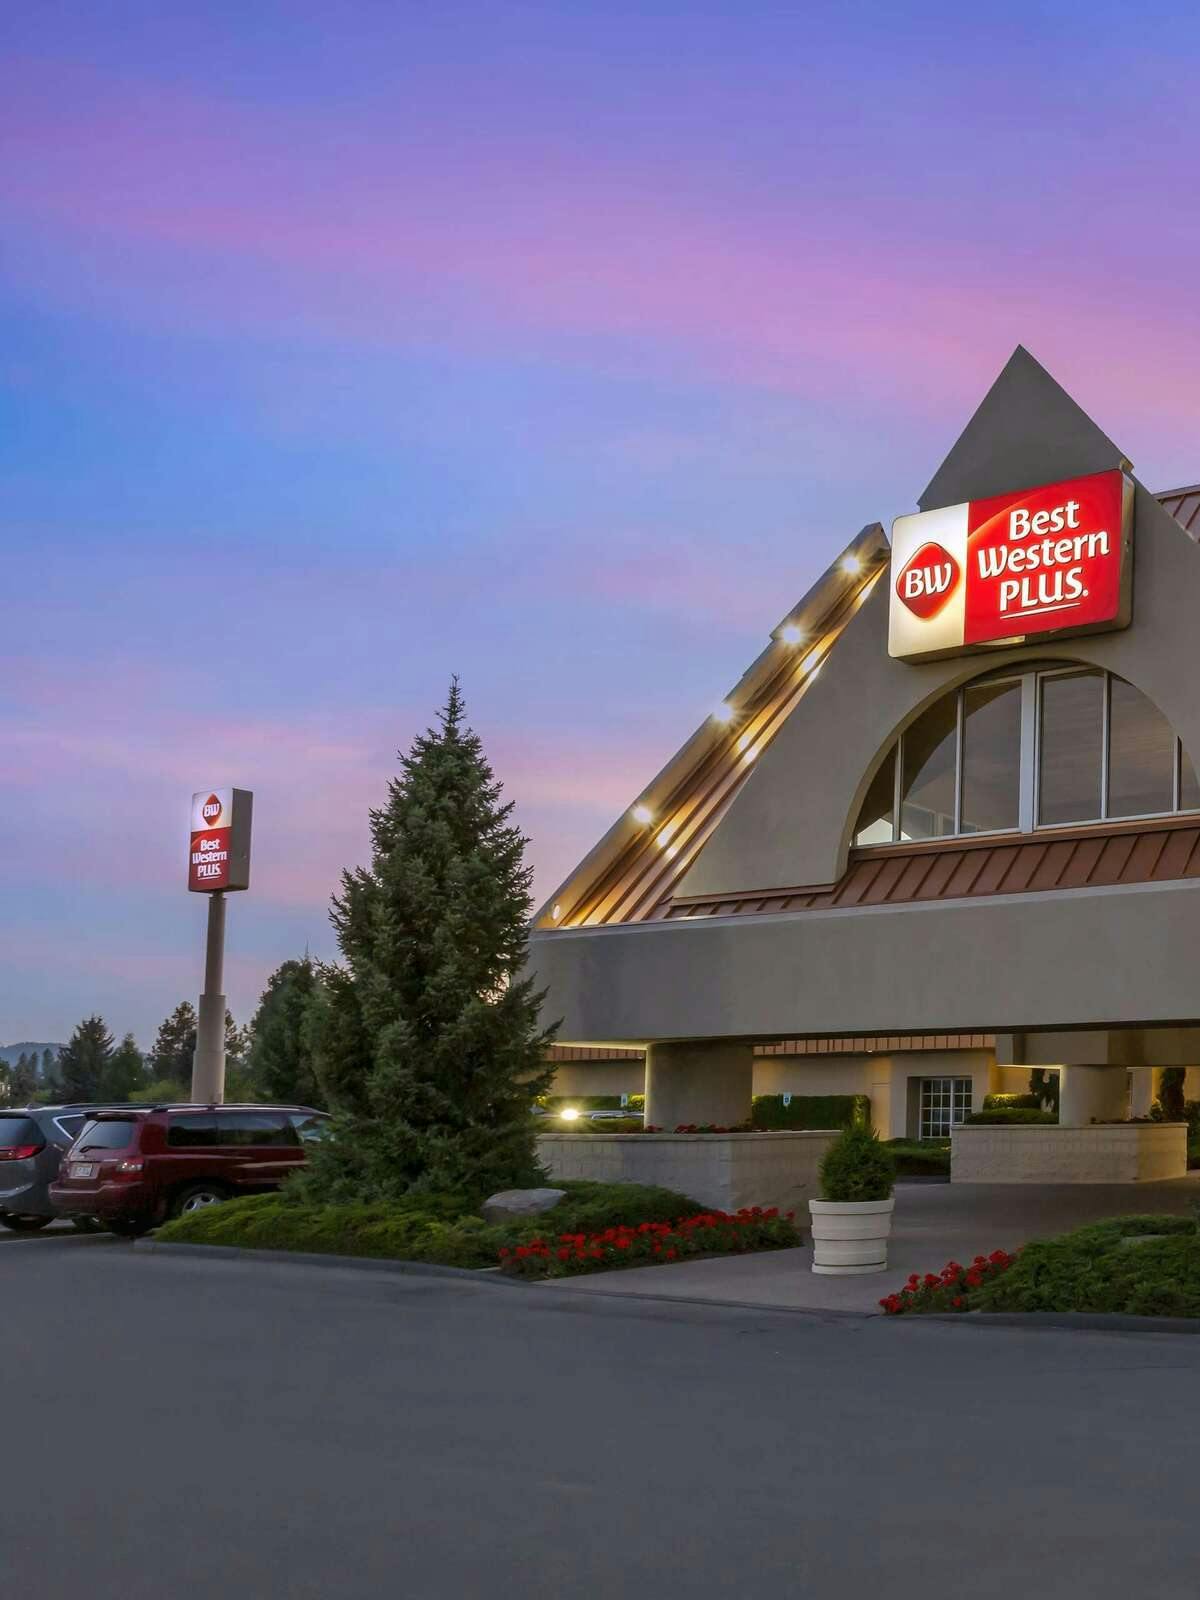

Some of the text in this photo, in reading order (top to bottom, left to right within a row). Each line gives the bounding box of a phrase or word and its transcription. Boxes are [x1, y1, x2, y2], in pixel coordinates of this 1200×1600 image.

[1009, 500, 1080, 541] Best
[977, 530, 1109, 579] Western
[905, 562, 952, 598] BW
[203, 803, 220, 817] BW
[192, 851, 227, 864] Western
[200, 839, 220, 851] Best
